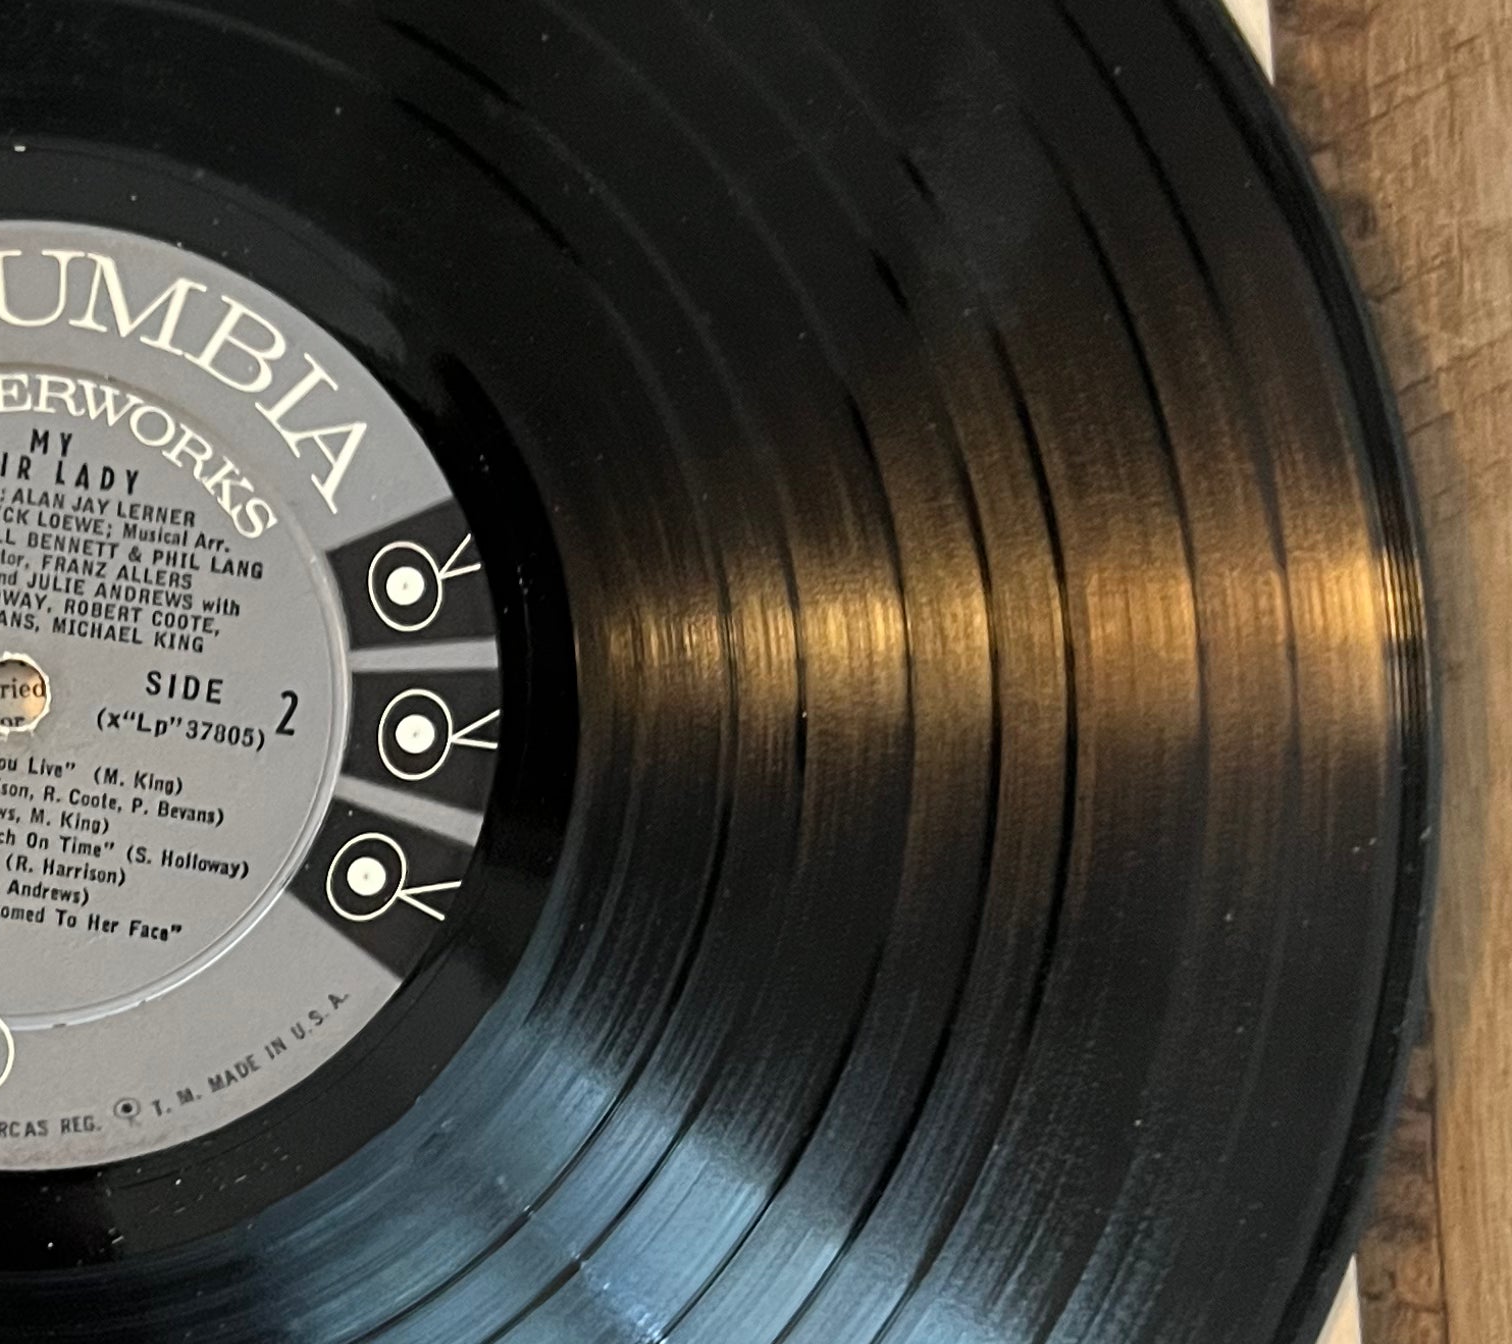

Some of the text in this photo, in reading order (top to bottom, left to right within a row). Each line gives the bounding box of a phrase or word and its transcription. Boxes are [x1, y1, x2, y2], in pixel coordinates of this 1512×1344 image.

[30, 428, 73, 457] MY
[55, 460, 139, 496] LADY
[11, 487, 65, 509] ALAN
[71, 496, 110, 516] JAY
[116, 500, 195, 528] LERNER
[37, 510, 112, 539] LOEWE;
[123, 522, 188, 547] Musical
[194, 532, 230, 553] Arr.
[27, 531, 120, 560] BENNETT
[128, 545, 142, 563] &
[152, 549, 200, 571] PHIL
[210, 555, 263, 580] LANG
[41, 554, 107, 579] FRANZ
[115, 564, 192, 590] ALLERS
[26, 572, 85, 596] JULIE
[94, 582, 193, 610] ANDREWS
[202, 597, 240, 617] with
[52, 616, 143, 645] MICHAEL
[153, 631, 204, 653] KING
[64, 598, 143, 623] ROBERT
[151, 610, 220, 637] COOTE,
[145, 670, 299, 736] SIDE 2
[93, 766, 125, 787] (M.
[134, 770, 183, 796] King)
[55, 908, 77, 928] To
[87, 913, 119, 934] Her
[208, 1053, 261, 1093] MADE
[265, 1036, 288, 1060] IN
